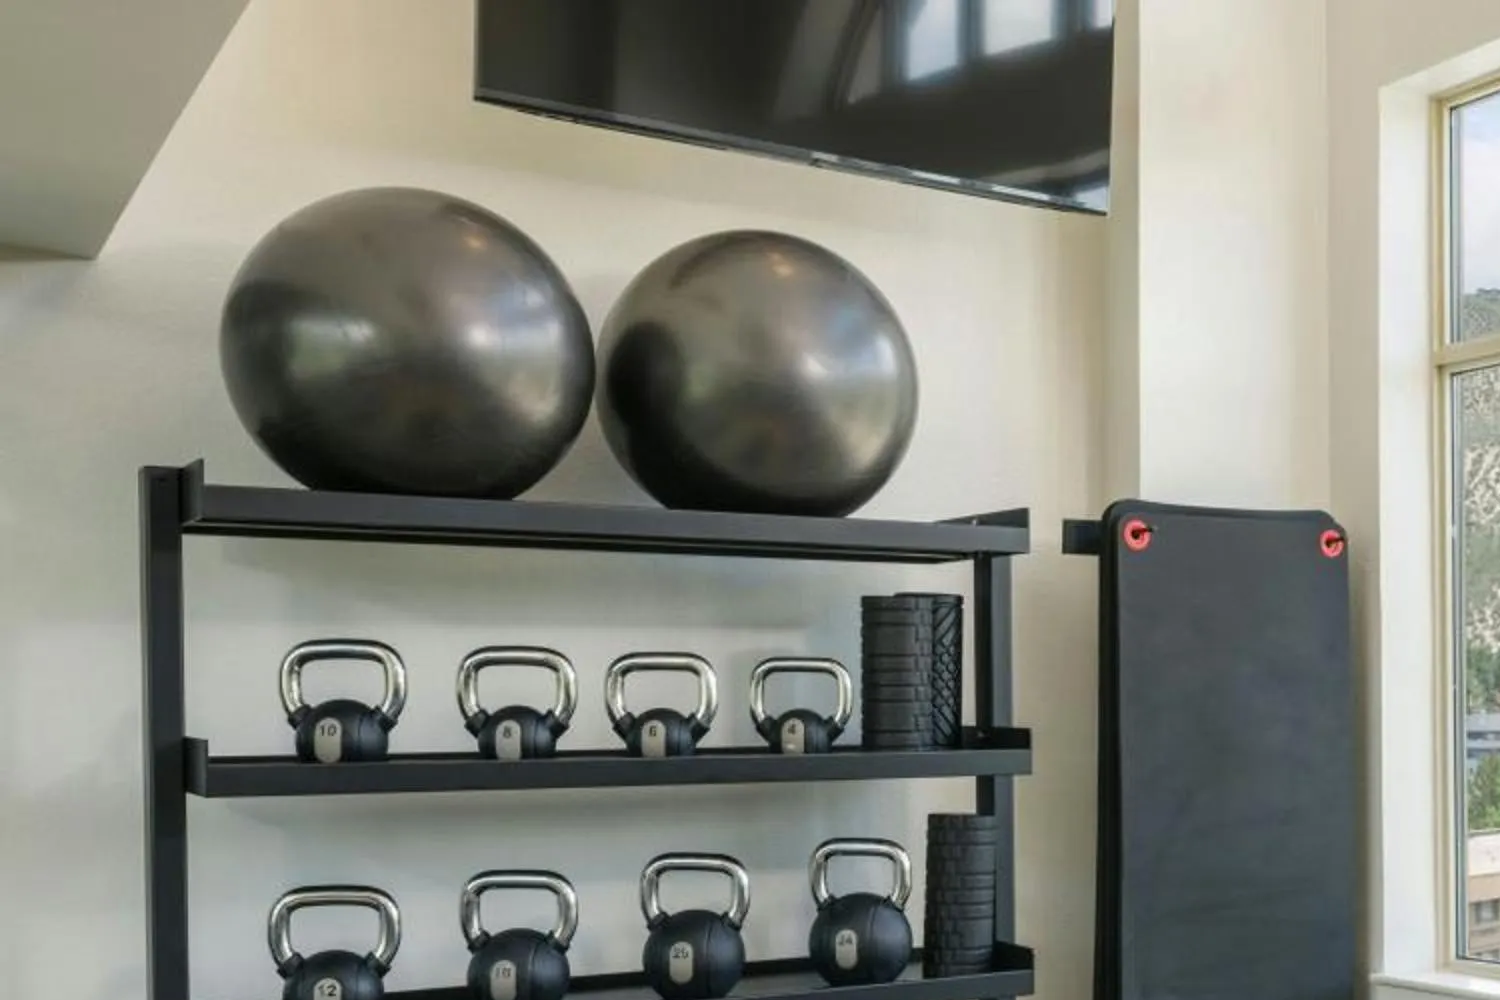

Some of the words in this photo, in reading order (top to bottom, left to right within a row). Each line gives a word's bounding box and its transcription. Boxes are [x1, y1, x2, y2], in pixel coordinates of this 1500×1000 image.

[320, 724, 337, 737] 10
[502, 726, 512, 739] 8
[318, 985, 337, 997] 12
